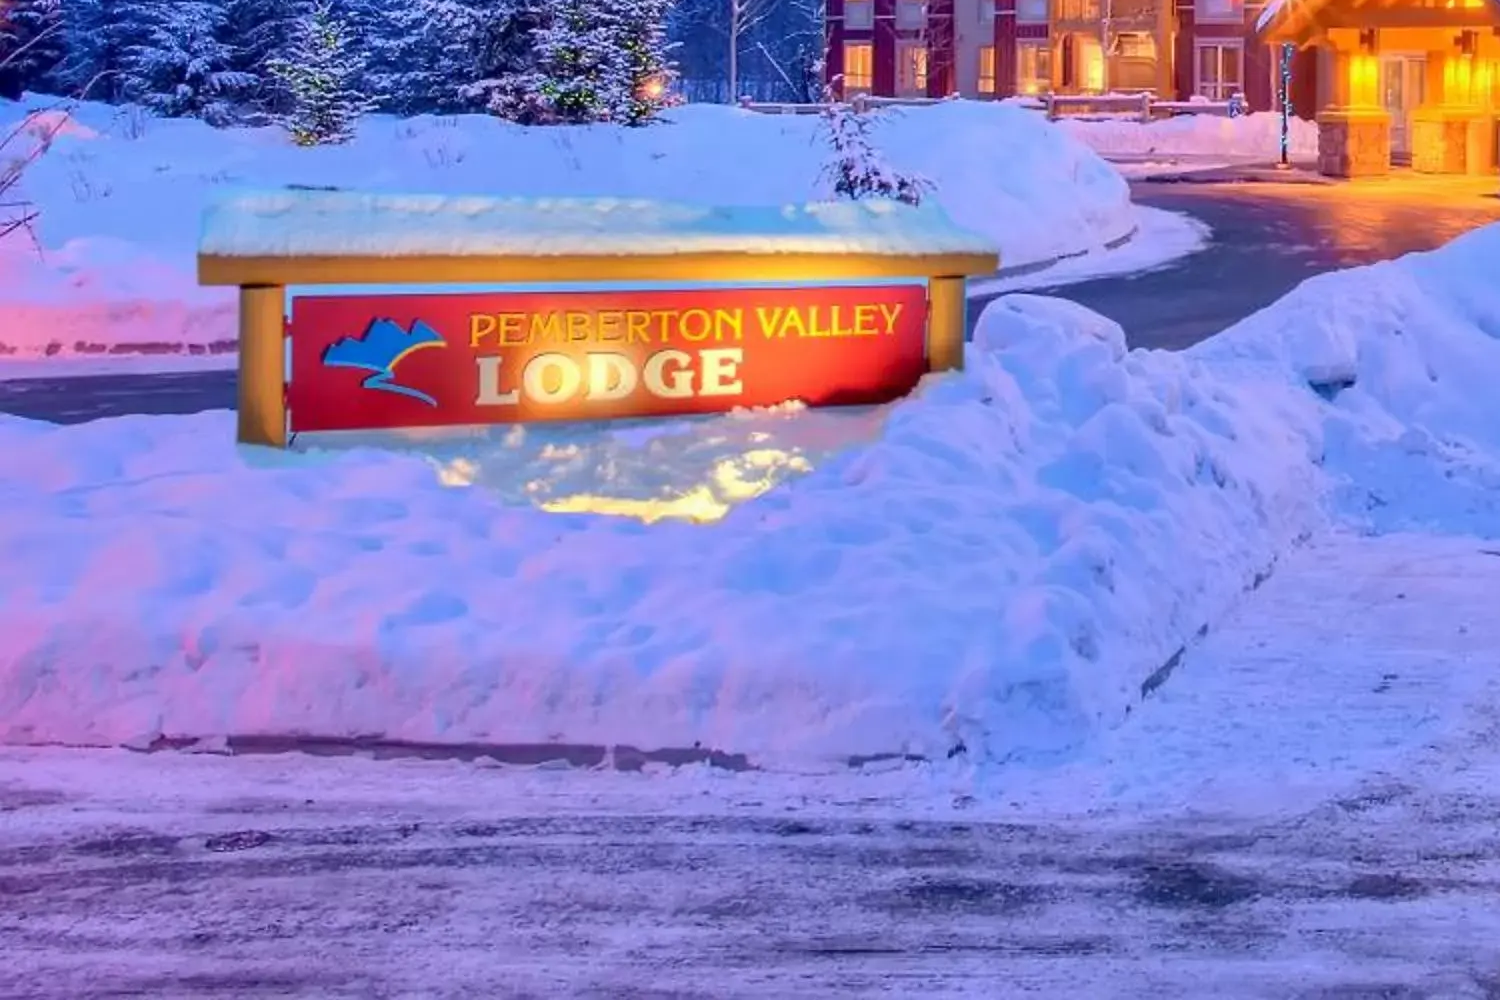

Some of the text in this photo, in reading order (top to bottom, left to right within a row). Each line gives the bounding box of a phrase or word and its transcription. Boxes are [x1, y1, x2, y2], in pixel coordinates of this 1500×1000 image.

[468, 303, 902, 348] PEMBERTON VALLEY
[475, 348, 744, 406] LODGE
